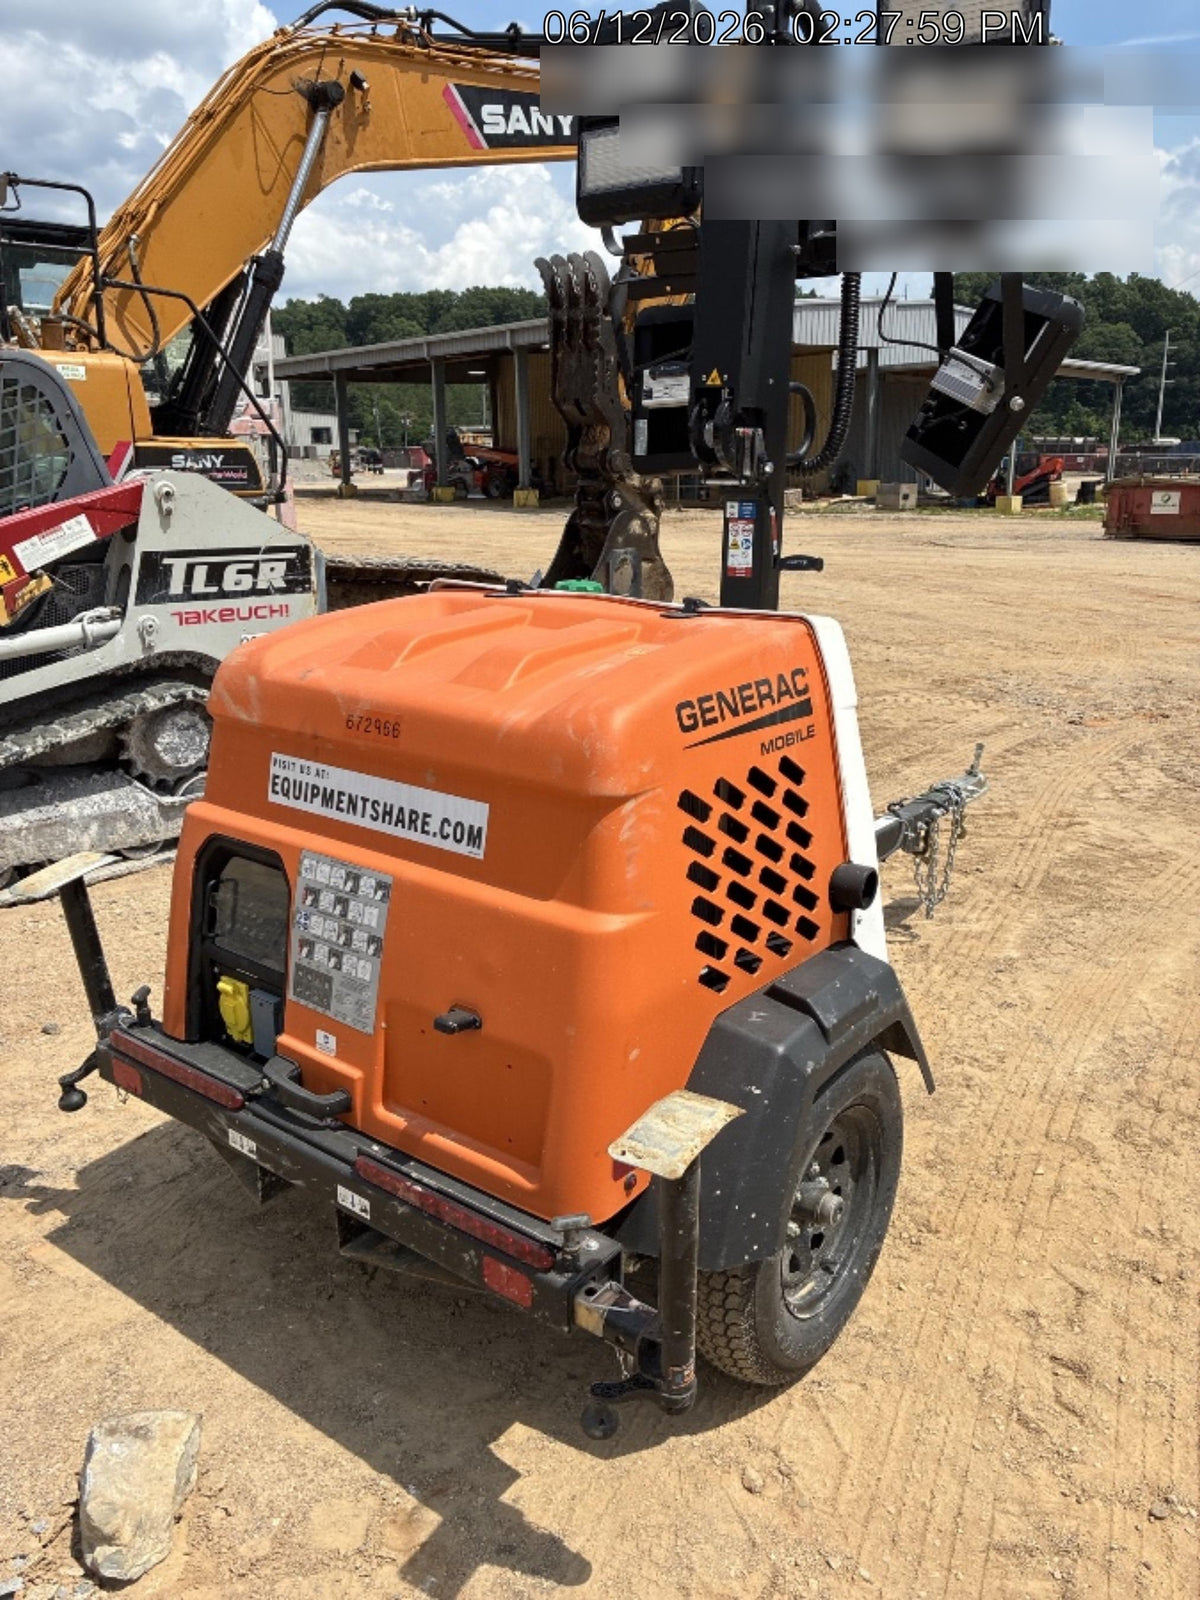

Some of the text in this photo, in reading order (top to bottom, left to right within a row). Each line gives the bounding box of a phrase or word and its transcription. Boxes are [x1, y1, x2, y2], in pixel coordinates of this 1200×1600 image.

[481, 104, 574, 136] SANY
[171, 454, 224, 468] SANY
[162, 552, 297, 595] TL6R
[675, 667, 810, 733] GENERAC
[345, 714, 401, 739] 672966
[760, 724, 816, 756] MOBILE
[273, 757, 296, 772] VISIT
[300, 763, 312, 776] US
[271, 773, 484, 850] EQUIPMENTSHARE.COM
